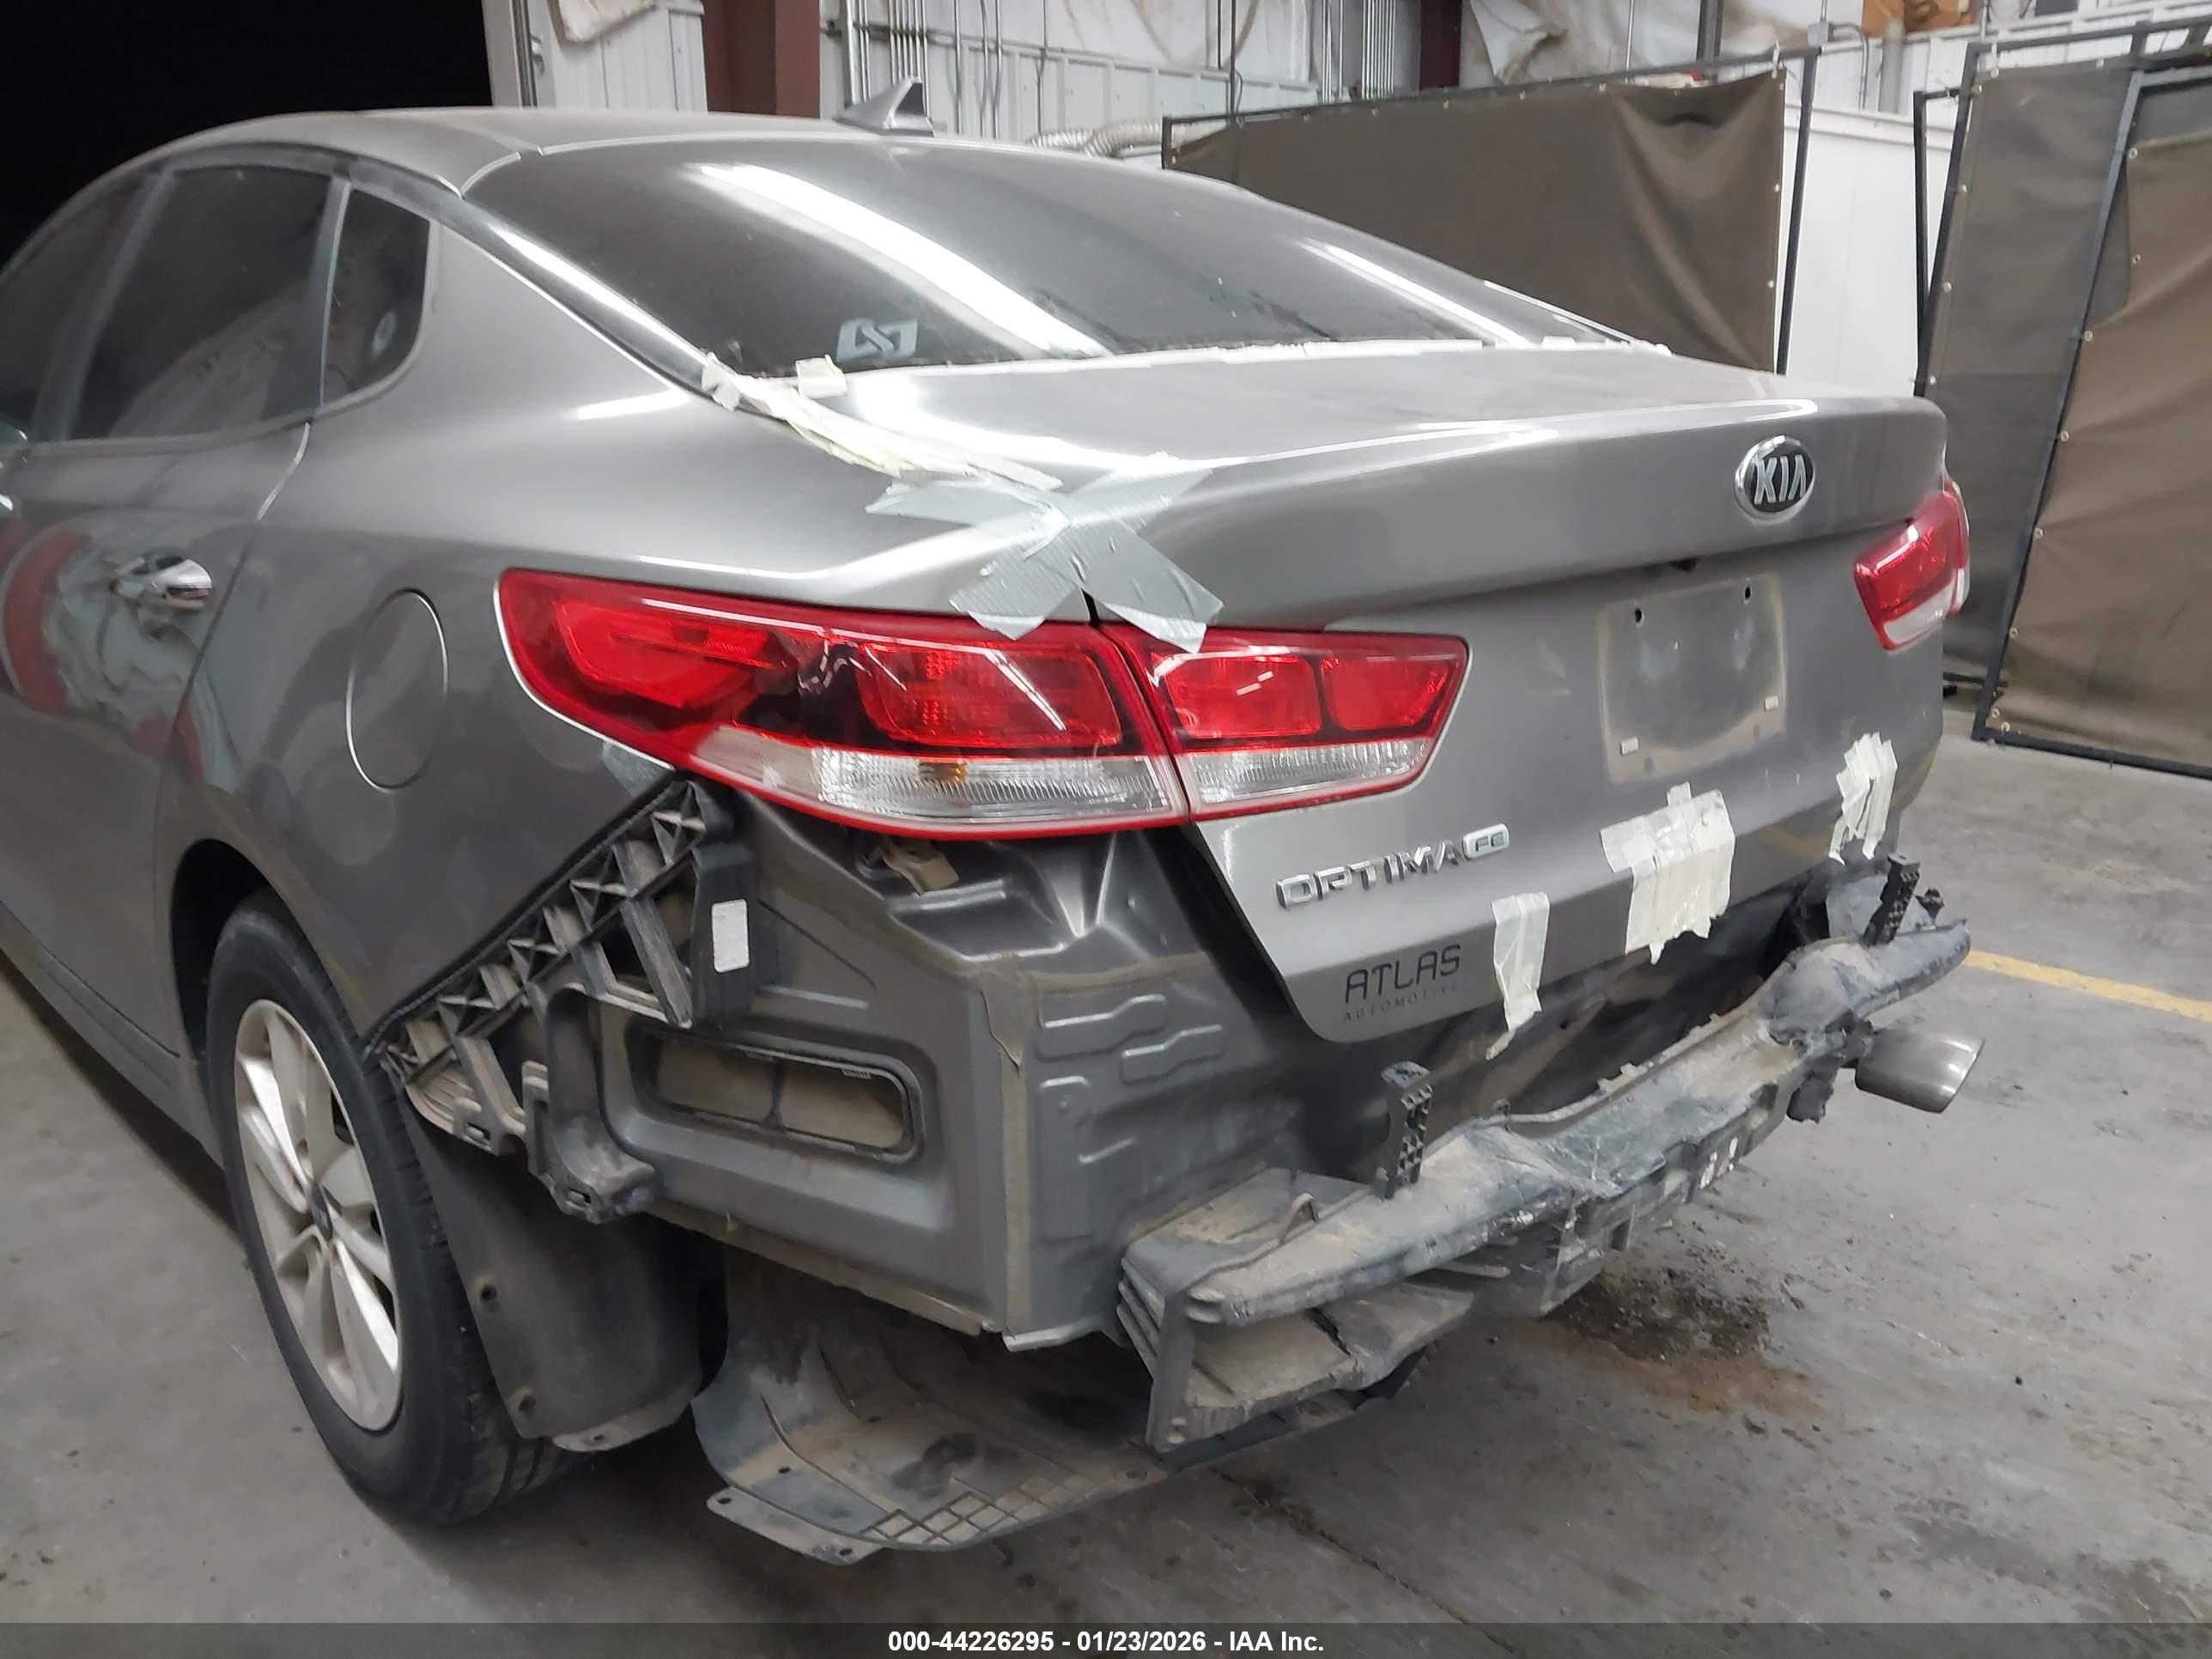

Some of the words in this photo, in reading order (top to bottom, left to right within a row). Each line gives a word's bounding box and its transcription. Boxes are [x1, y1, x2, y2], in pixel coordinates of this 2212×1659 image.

[1753, 453, 1807, 505] KIA
[1275, 839, 1463, 908] OPTIMA
[1344, 944, 1462, 1005] ATLAS
